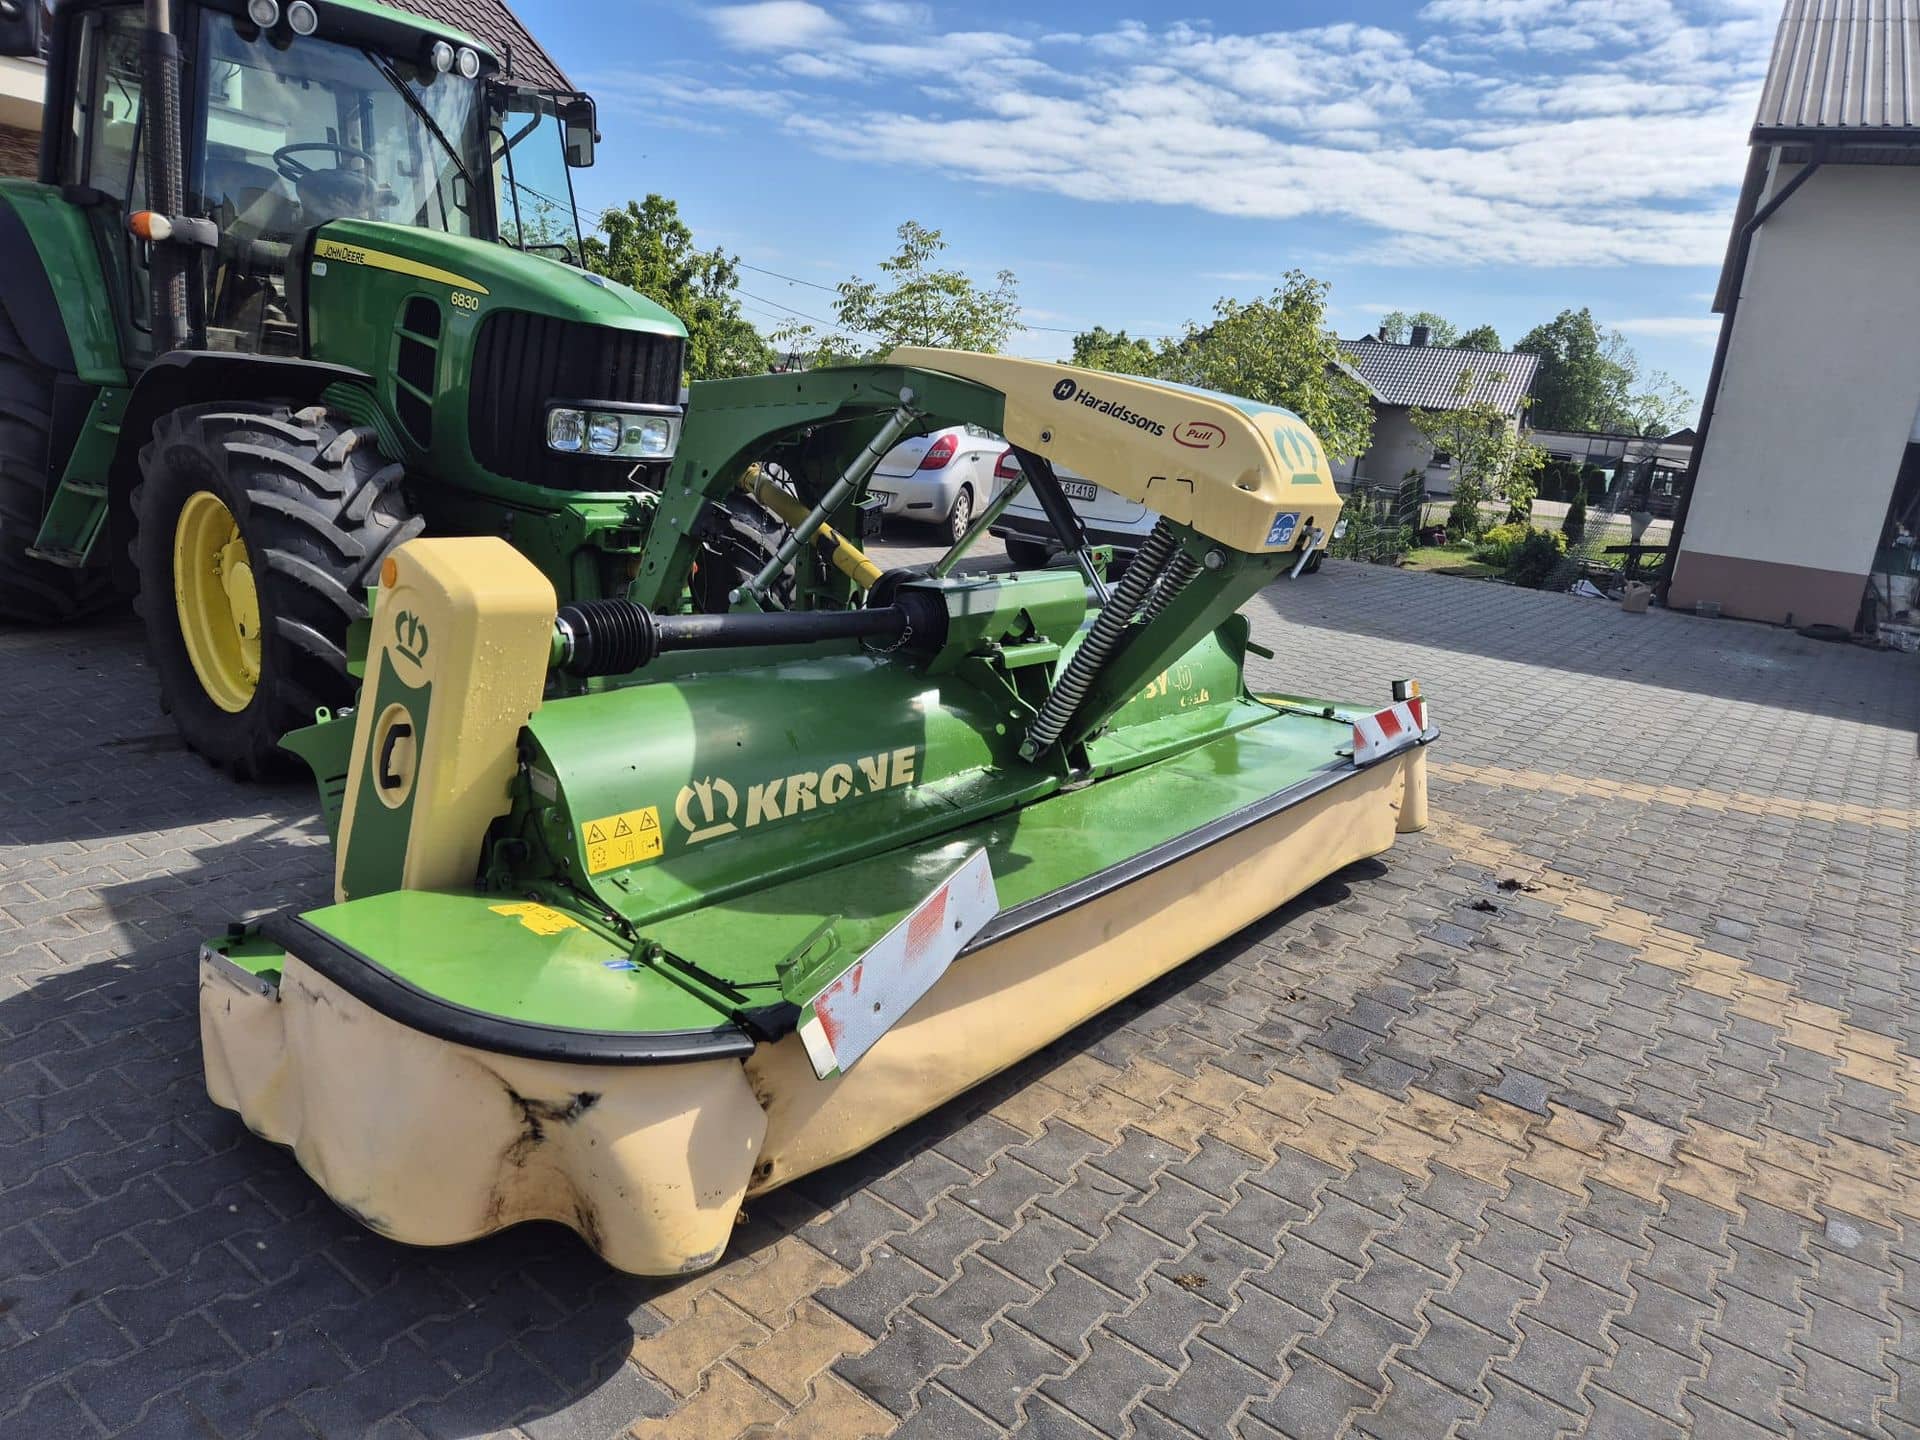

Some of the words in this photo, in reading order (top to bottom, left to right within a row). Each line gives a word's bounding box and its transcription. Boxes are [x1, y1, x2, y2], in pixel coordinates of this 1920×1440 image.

[324, 244, 342, 259] JOHN
[341, 247, 366, 264] DEERE
[451, 291, 479, 311] 6830
[1075, 389, 1165, 437] Haraldssons
[1186, 429, 1213, 440] Pull
[1064, 483, 1095, 498] 81418
[746, 745, 916, 828] KRONE
